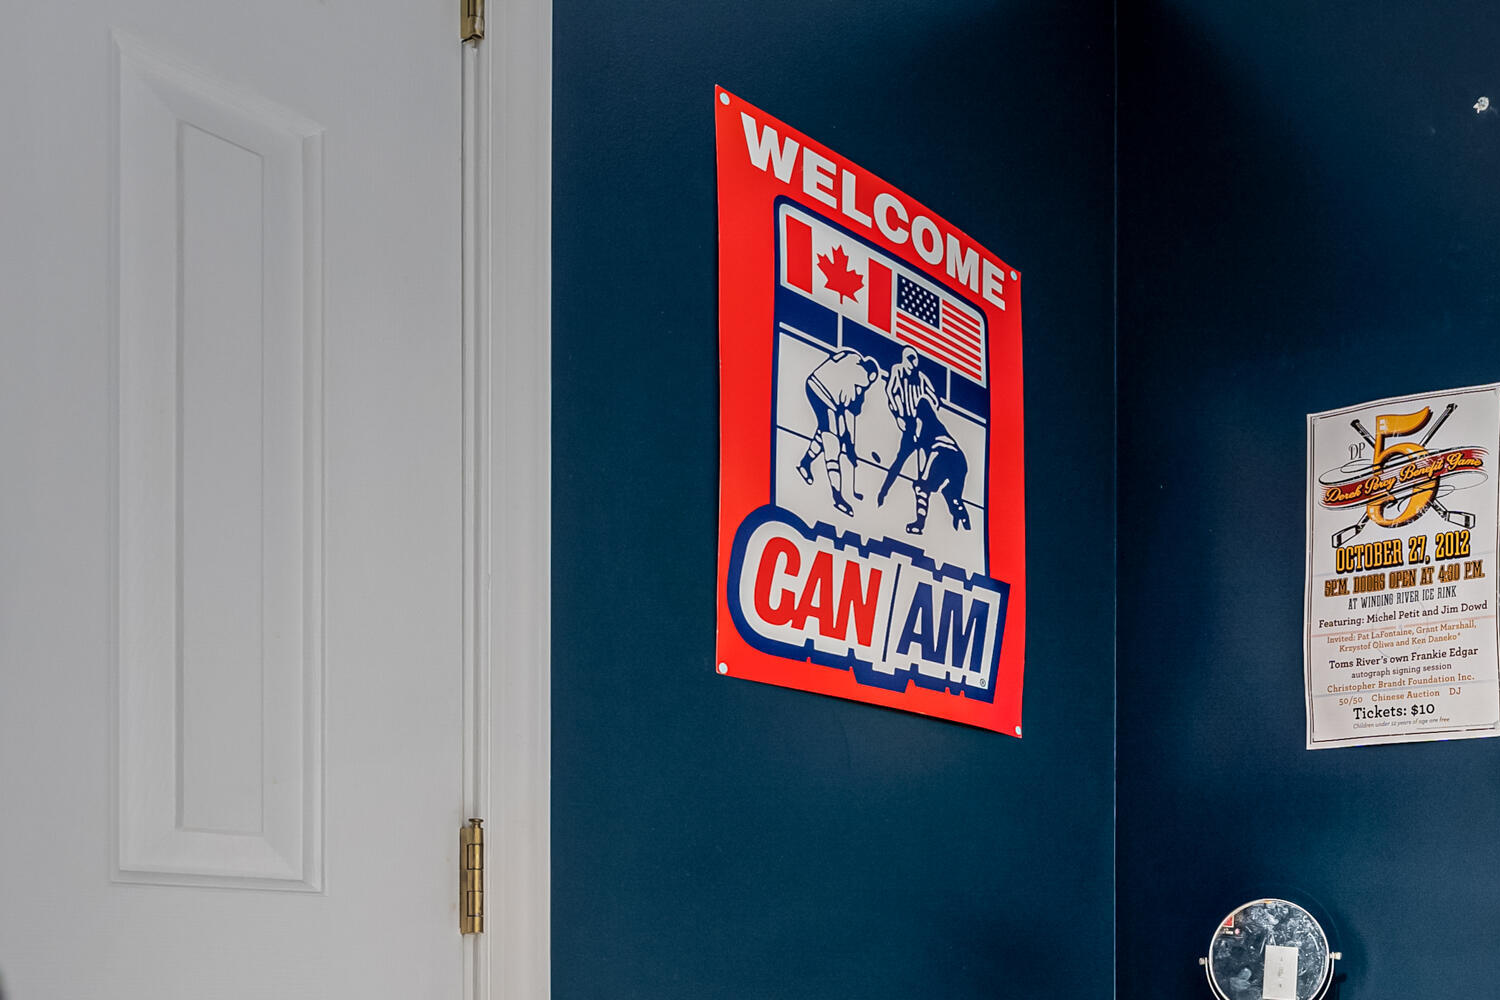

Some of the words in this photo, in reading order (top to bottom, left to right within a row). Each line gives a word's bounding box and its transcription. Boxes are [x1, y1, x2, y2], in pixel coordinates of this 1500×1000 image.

[740, 111, 1006, 311] WELCOME
[1399, 459, 1445, 482] Benefit
[1446, 452, 1485, 472] Game
[1335, 538, 1404, 574] OCTOBER
[1408, 534, 1431, 565] 27,
[1435, 529, 1472, 562] 2012
[1352, 572, 1386, 595] DOORS
[1389, 568, 1417, 590] OPEN
[1420, 565, 1435, 586] AT
[1348, 597, 1357, 610] AT
[1360, 593, 1394, 609] WINDING
[1396, 590, 1419, 605] RIVER
[1422, 588, 1435, 601] ICE
[1437, 585, 1457, 599] RINK
[1318, 617, 1365, 629] Featuring:
[1366, 610, 1397, 624] Michel
[1399, 607, 1420, 620] Petit
[1422, 605, 1439, 617] and
[1441, 604, 1459, 615] Jim
[1461, 600, 1488, 612] Dowd
[1327, 633, 1357, 644] Invited:
[1357, 631, 1370, 642] Pat
[1371, 627, 1415, 640] LaFontaine,
[1416, 624, 1439, 635] Grant
[1440, 619, 1477, 632] Marshall,
[1372, 640, 1395, 650] Oliwa
[1395, 638, 1410, 648] and
[1411, 636, 1427, 647] Ken
[1329, 659, 1354, 670] Toms
[1389, 654, 1409, 663] own
[1411, 648, 1447, 661] Frankie
[1449, 646, 1479, 660] Edgar
[1327, 682, 1376, 695] Christopher
[1378, 677, 1406, 689] Brandt
[1408, 674, 1456, 687] Foundation
[1458, 672, 1475, 682] Inc.
[1351, 668, 1391, 680] autograph
[1392, 664, 1421, 676] signing
[1422, 662, 1452, 672] session
[1338, 696, 1363, 707] 50/50
[1371, 692, 1405, 703] Chinese
[1406, 689, 1440, 700] Auction
[1449, 686, 1462, 697] DJ
[1353, 704, 1408, 720] Tickets:
[1410, 703, 1435, 717] $10
